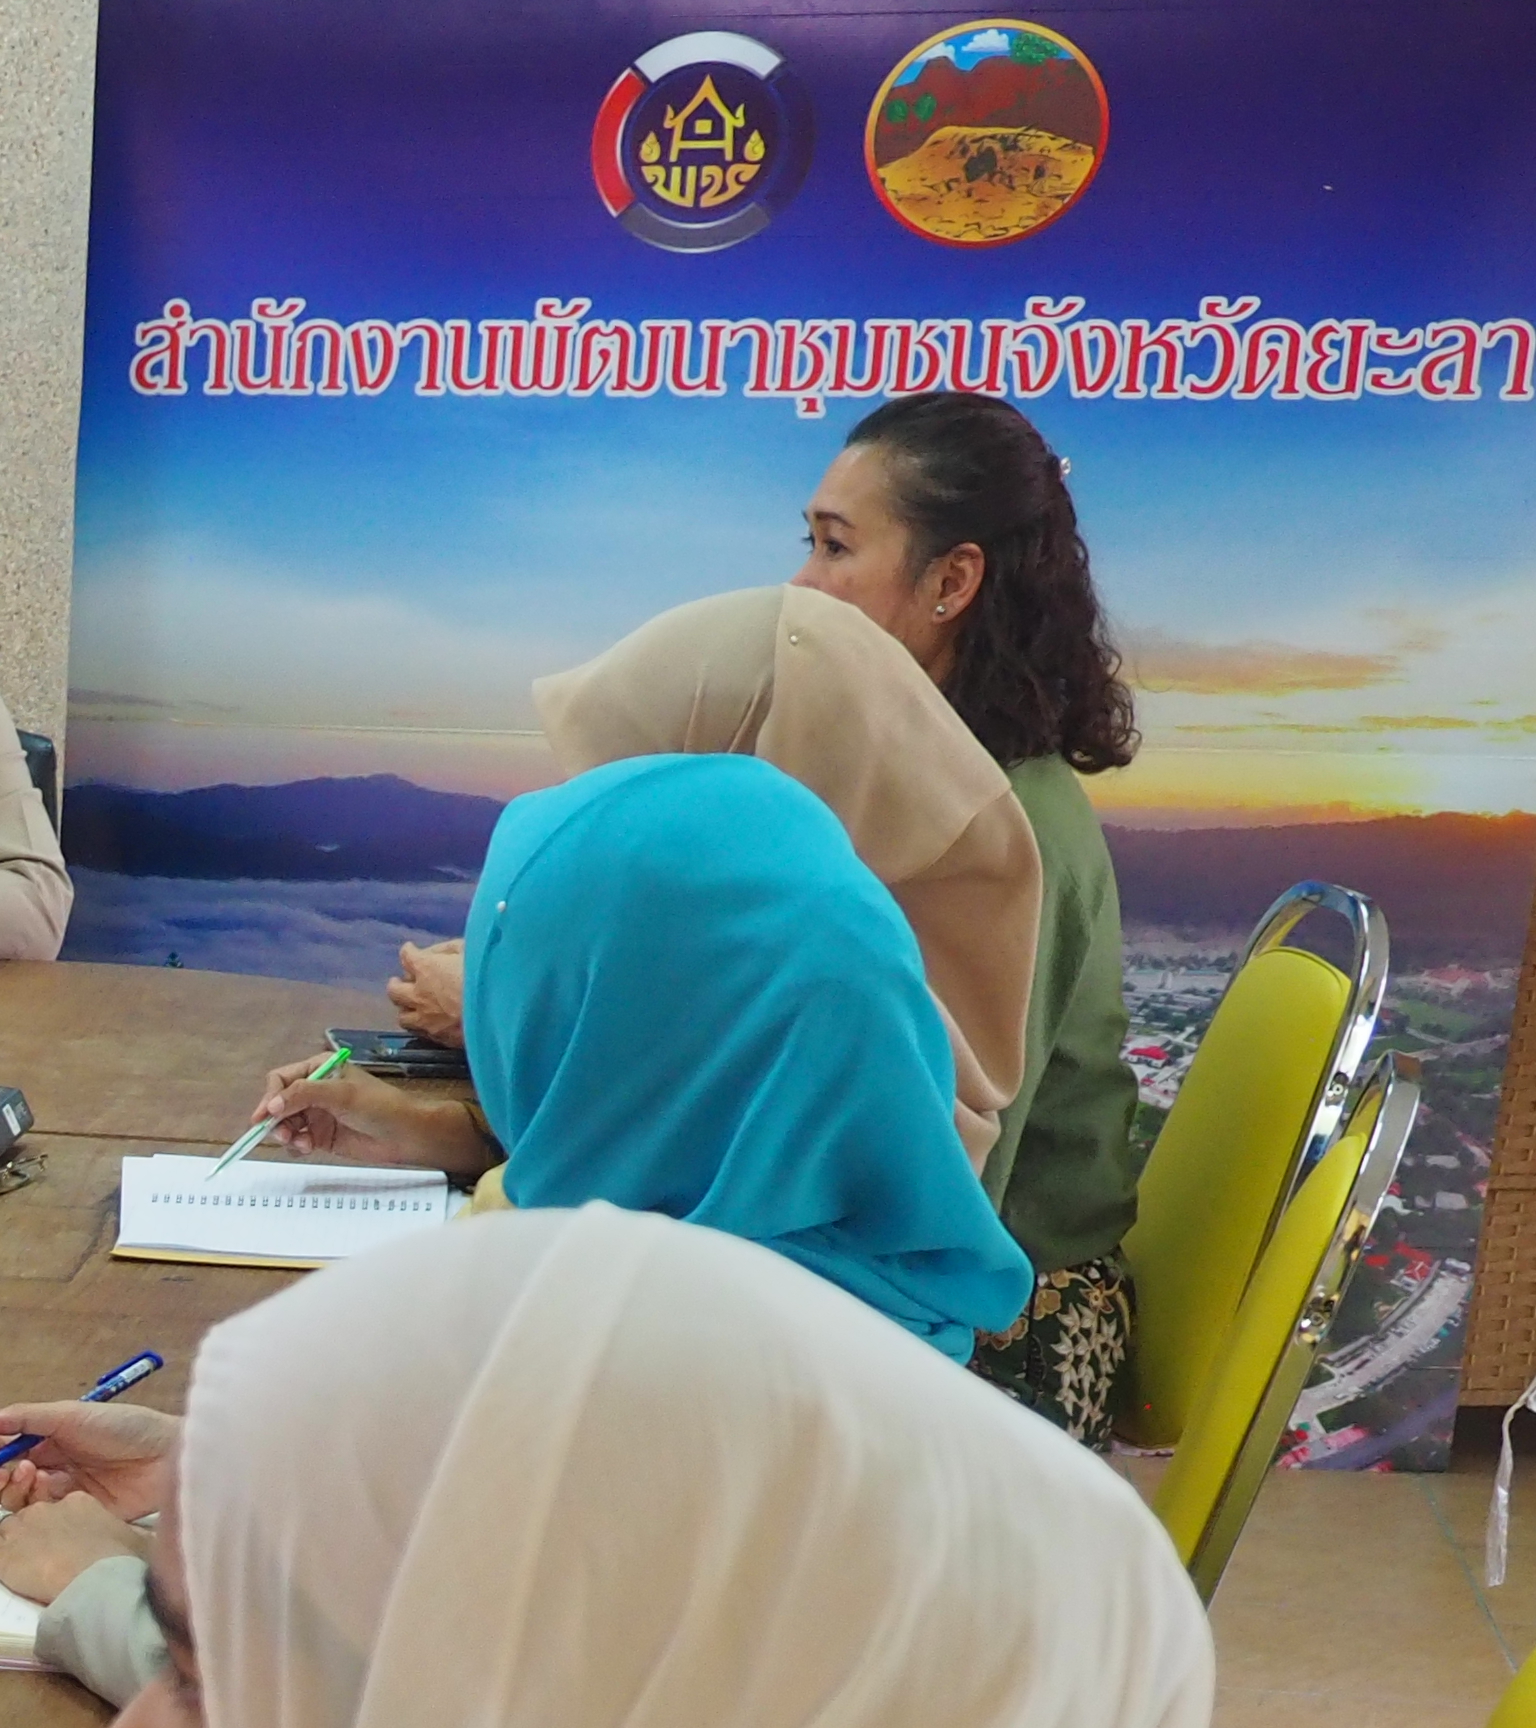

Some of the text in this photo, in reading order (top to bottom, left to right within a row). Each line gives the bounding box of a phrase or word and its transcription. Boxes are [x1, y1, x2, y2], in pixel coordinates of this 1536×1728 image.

[130, 294, 1535, 418] สำนักงานพัฒนาชุมชนจังหวัดยะลา
